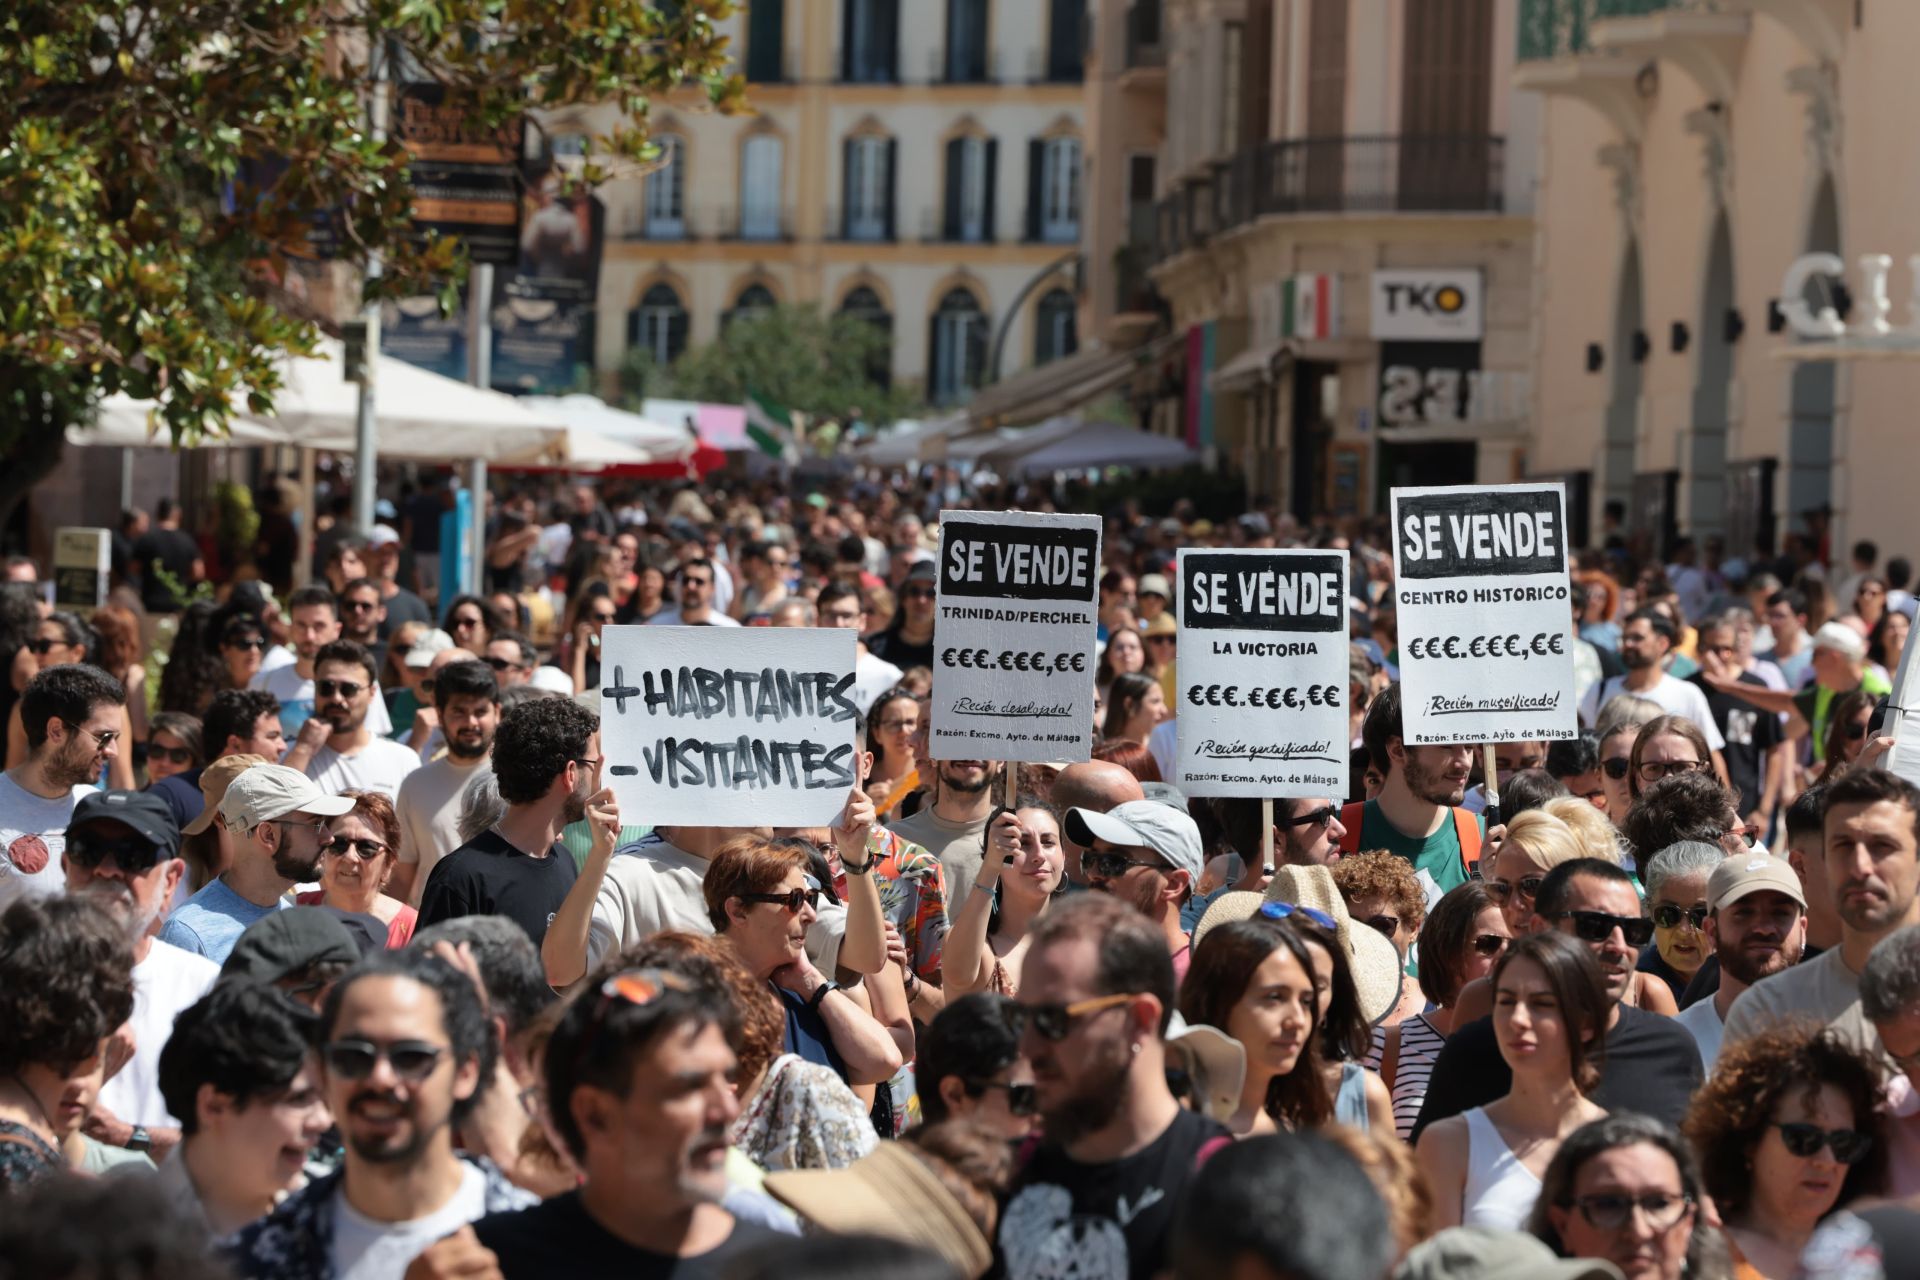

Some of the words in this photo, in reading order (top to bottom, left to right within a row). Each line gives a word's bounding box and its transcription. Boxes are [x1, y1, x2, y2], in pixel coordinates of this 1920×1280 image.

[1404, 515, 1442, 561] SE
[1449, 512, 1556, 559] VENDE
[949, 539, 985, 582] SE
[990, 542, 1088, 587] VENDE
[1192, 571, 1229, 615] SE
[1238, 569, 1338, 616] VENDE
[1400, 590, 1468, 605] CENTRO
[1473, 586, 1568, 603] HISTORICO
[942, 606, 1091, 624] TRINIDAD/PERCHEL
[1213, 641, 1233, 655] LA
[1238, 641, 1318, 657] VICTORIA
[1408, 632, 1564, 660] €€€.€€€,€€
[941, 648, 1085, 677] €€€.€€€,€€
[1187, 684, 1340, 711] €€€.€€€,€€
[936, 728, 967, 738] Razón:
[969, 729, 1004, 740] Excmo.
[1006, 732, 1031, 743] Ayto.
[1033, 733, 1044, 742] de
[1047, 733, 1081, 743] Málaga
[1415, 733, 1450, 743] Razón:
[1452, 732, 1489, 742] Excmo.
[1521, 729, 1533, 738] de
[1537, 728, 1574, 740] Málaga
[1185, 772, 1219, 782] Razón:
[1221, 773, 1257, 783] Excmo.
[1260, 774, 1286, 784] Ayto.
[1288, 773, 1301, 783] de
[1303, 772, 1338, 786] Málaga
